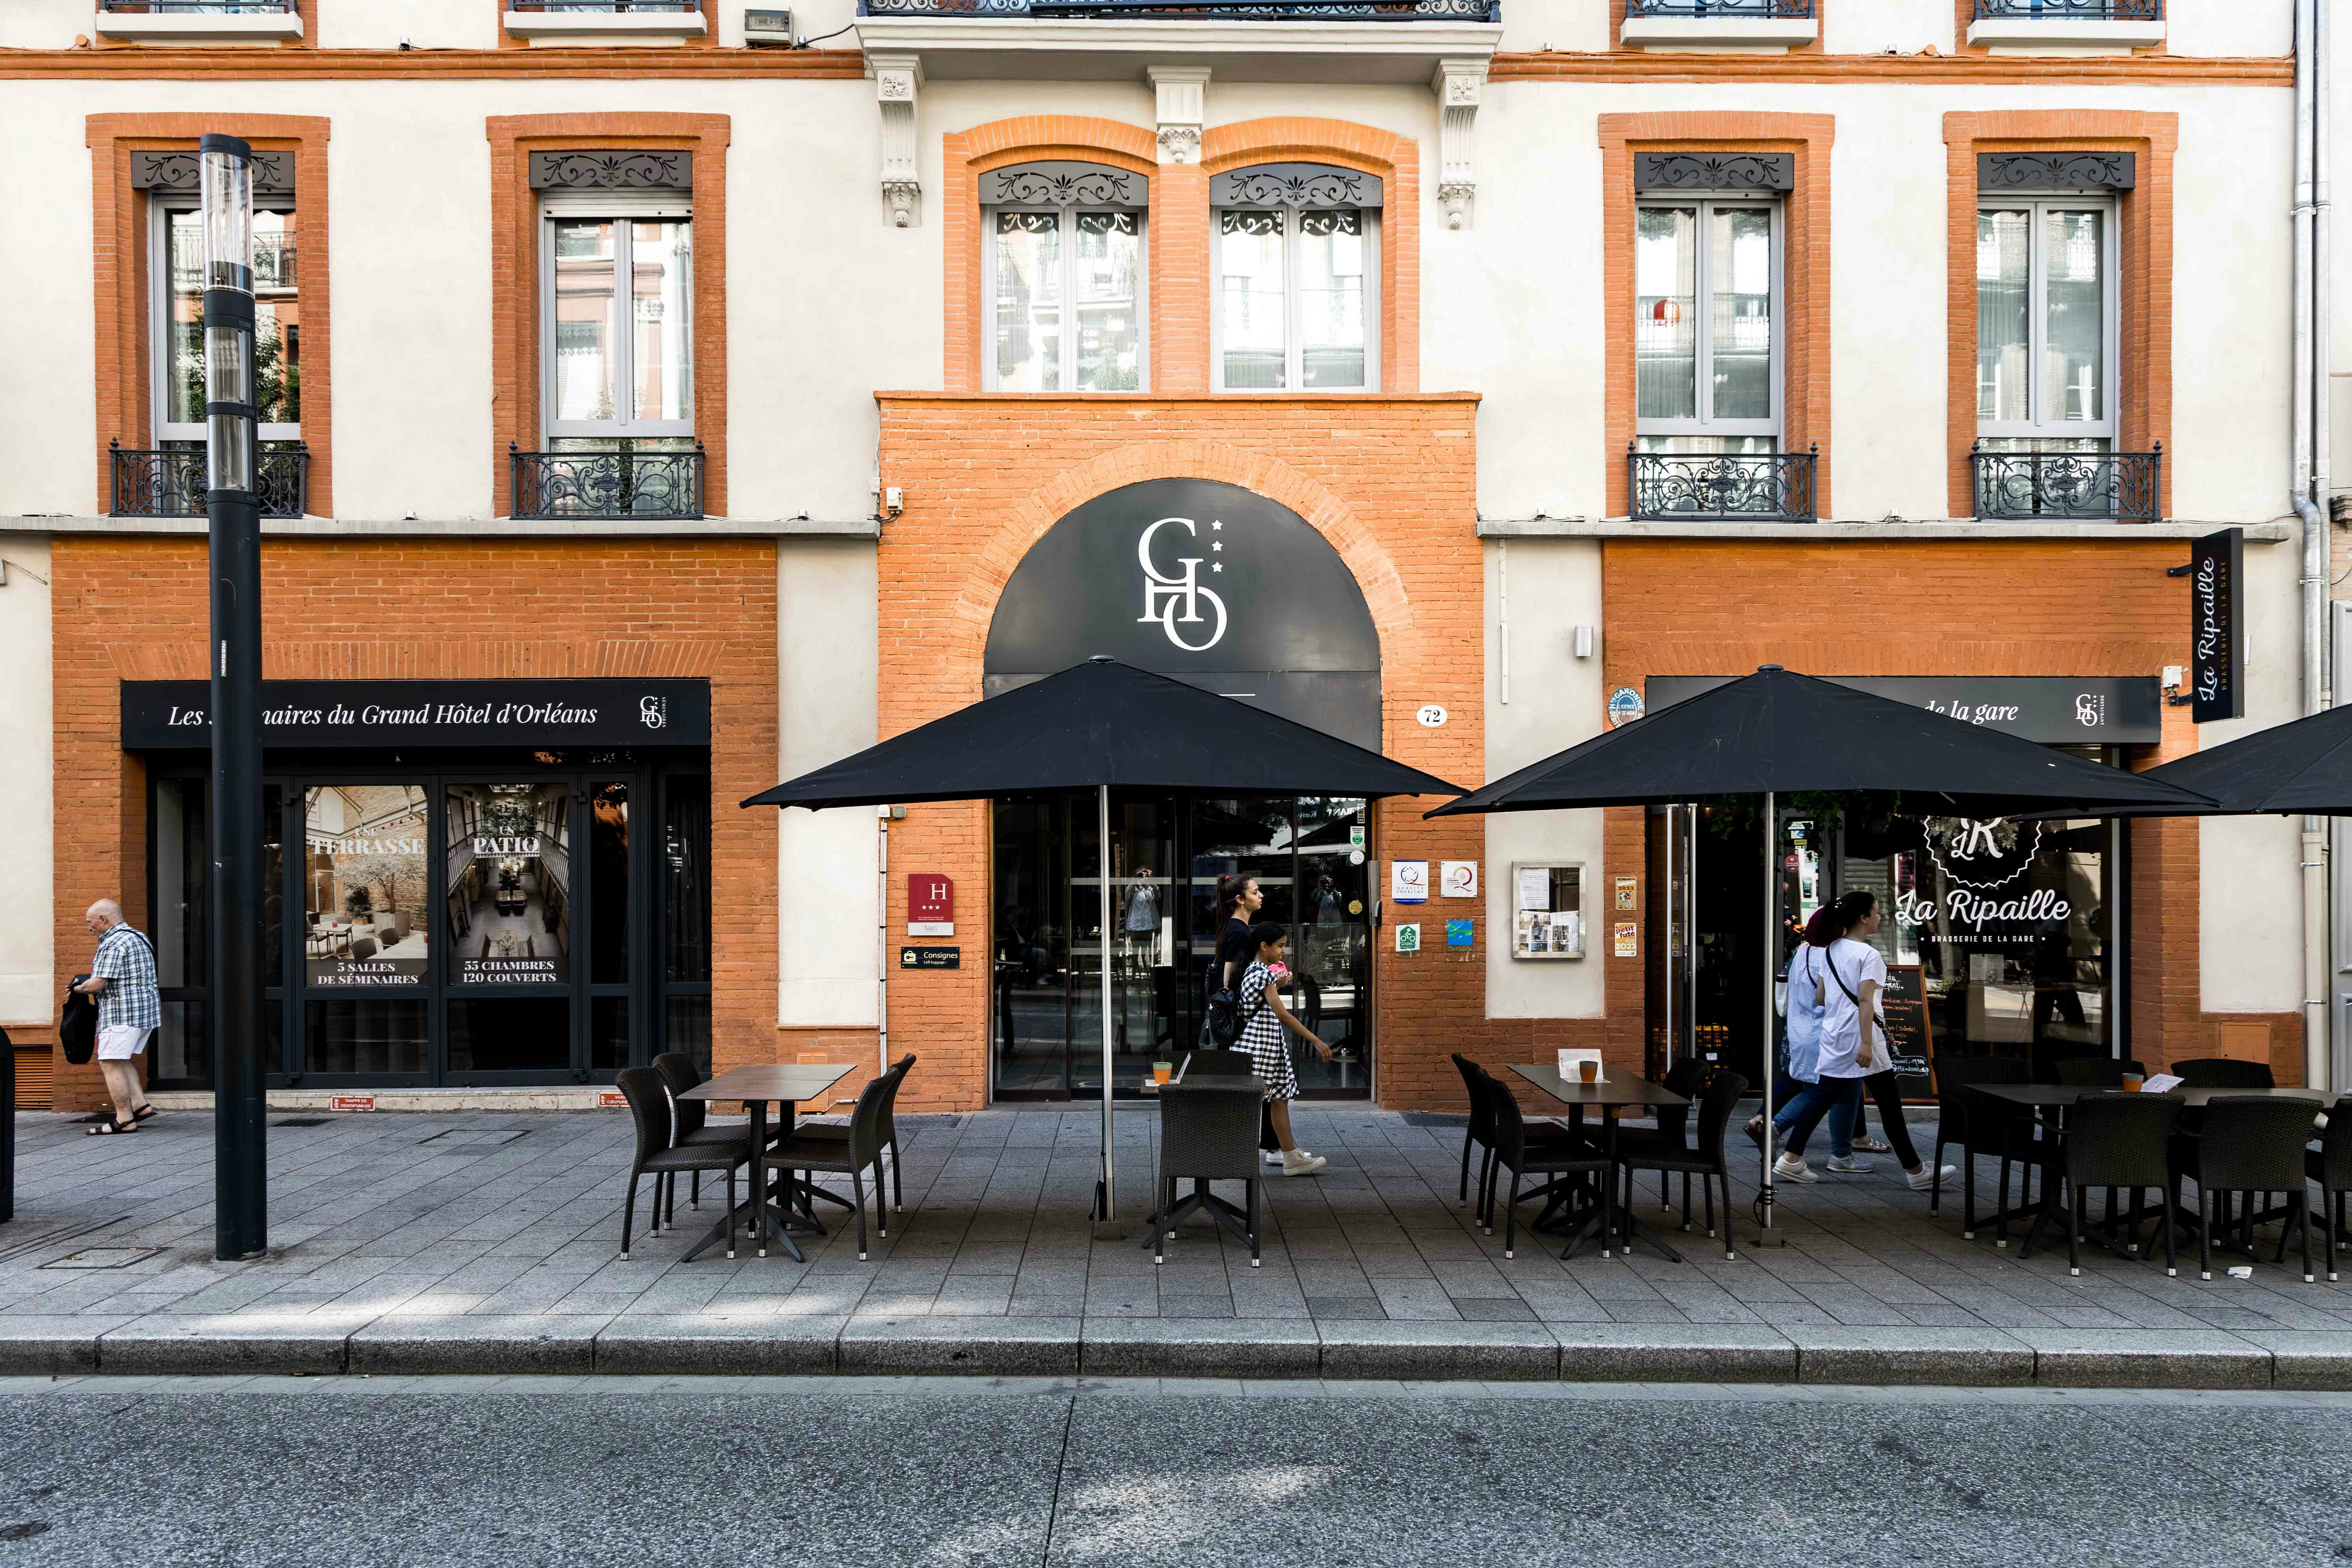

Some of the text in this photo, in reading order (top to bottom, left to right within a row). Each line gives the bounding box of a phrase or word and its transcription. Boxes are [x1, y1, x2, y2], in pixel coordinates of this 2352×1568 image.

[2198, 557, 2220, 701] La Ripaille
[1615, 688, 1644, 711] GARONNE
[167, 707, 203, 725] Les
[209, 705, 322, 725] naires
[328, 704, 355, 724] du
[362, 703, 430, 724] Grand
[434, 703, 492, 724] Hôtel
[1424, 710, 1440, 722] 72
[1950, 700, 1969, 720] la
[1972, 704, 2018, 725] gare
[499, 825, 515, 835] UN
[311, 839, 424, 854] TERRASSE
[473, 837, 540, 853] PATIO
[929, 884, 947, 900] H
[1895, 889, 2071, 932] La Ripaille
[1615, 925, 1634, 935] petit
[924, 952, 958, 960] Consignes
[338, 962, 396, 972] 5 SALLES
[465, 960, 554, 971] 55 CHAMBRES
[318, 973, 419, 984] DE SÉMINAIRES
[463, 973, 557, 983] 120 COUVERTS
